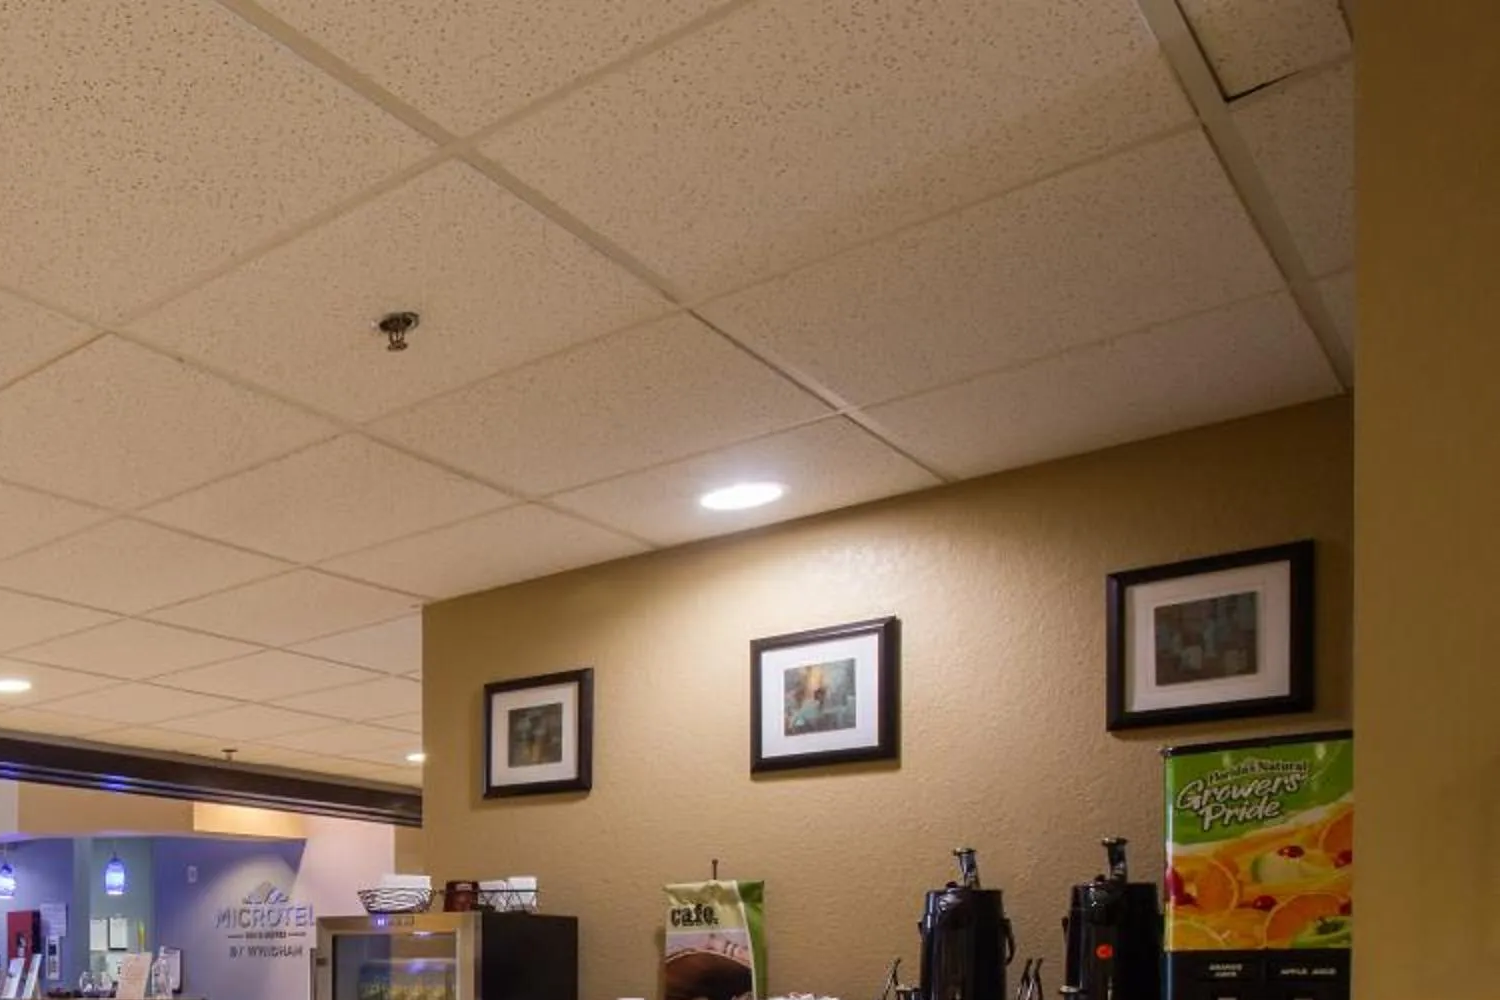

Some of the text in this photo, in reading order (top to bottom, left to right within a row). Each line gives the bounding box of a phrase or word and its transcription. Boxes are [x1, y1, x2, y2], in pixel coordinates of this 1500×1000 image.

[1199, 796, 1281, 831] Pride
[214, 904, 315, 929] MICROTEL
[229, 945, 245, 958] BY
